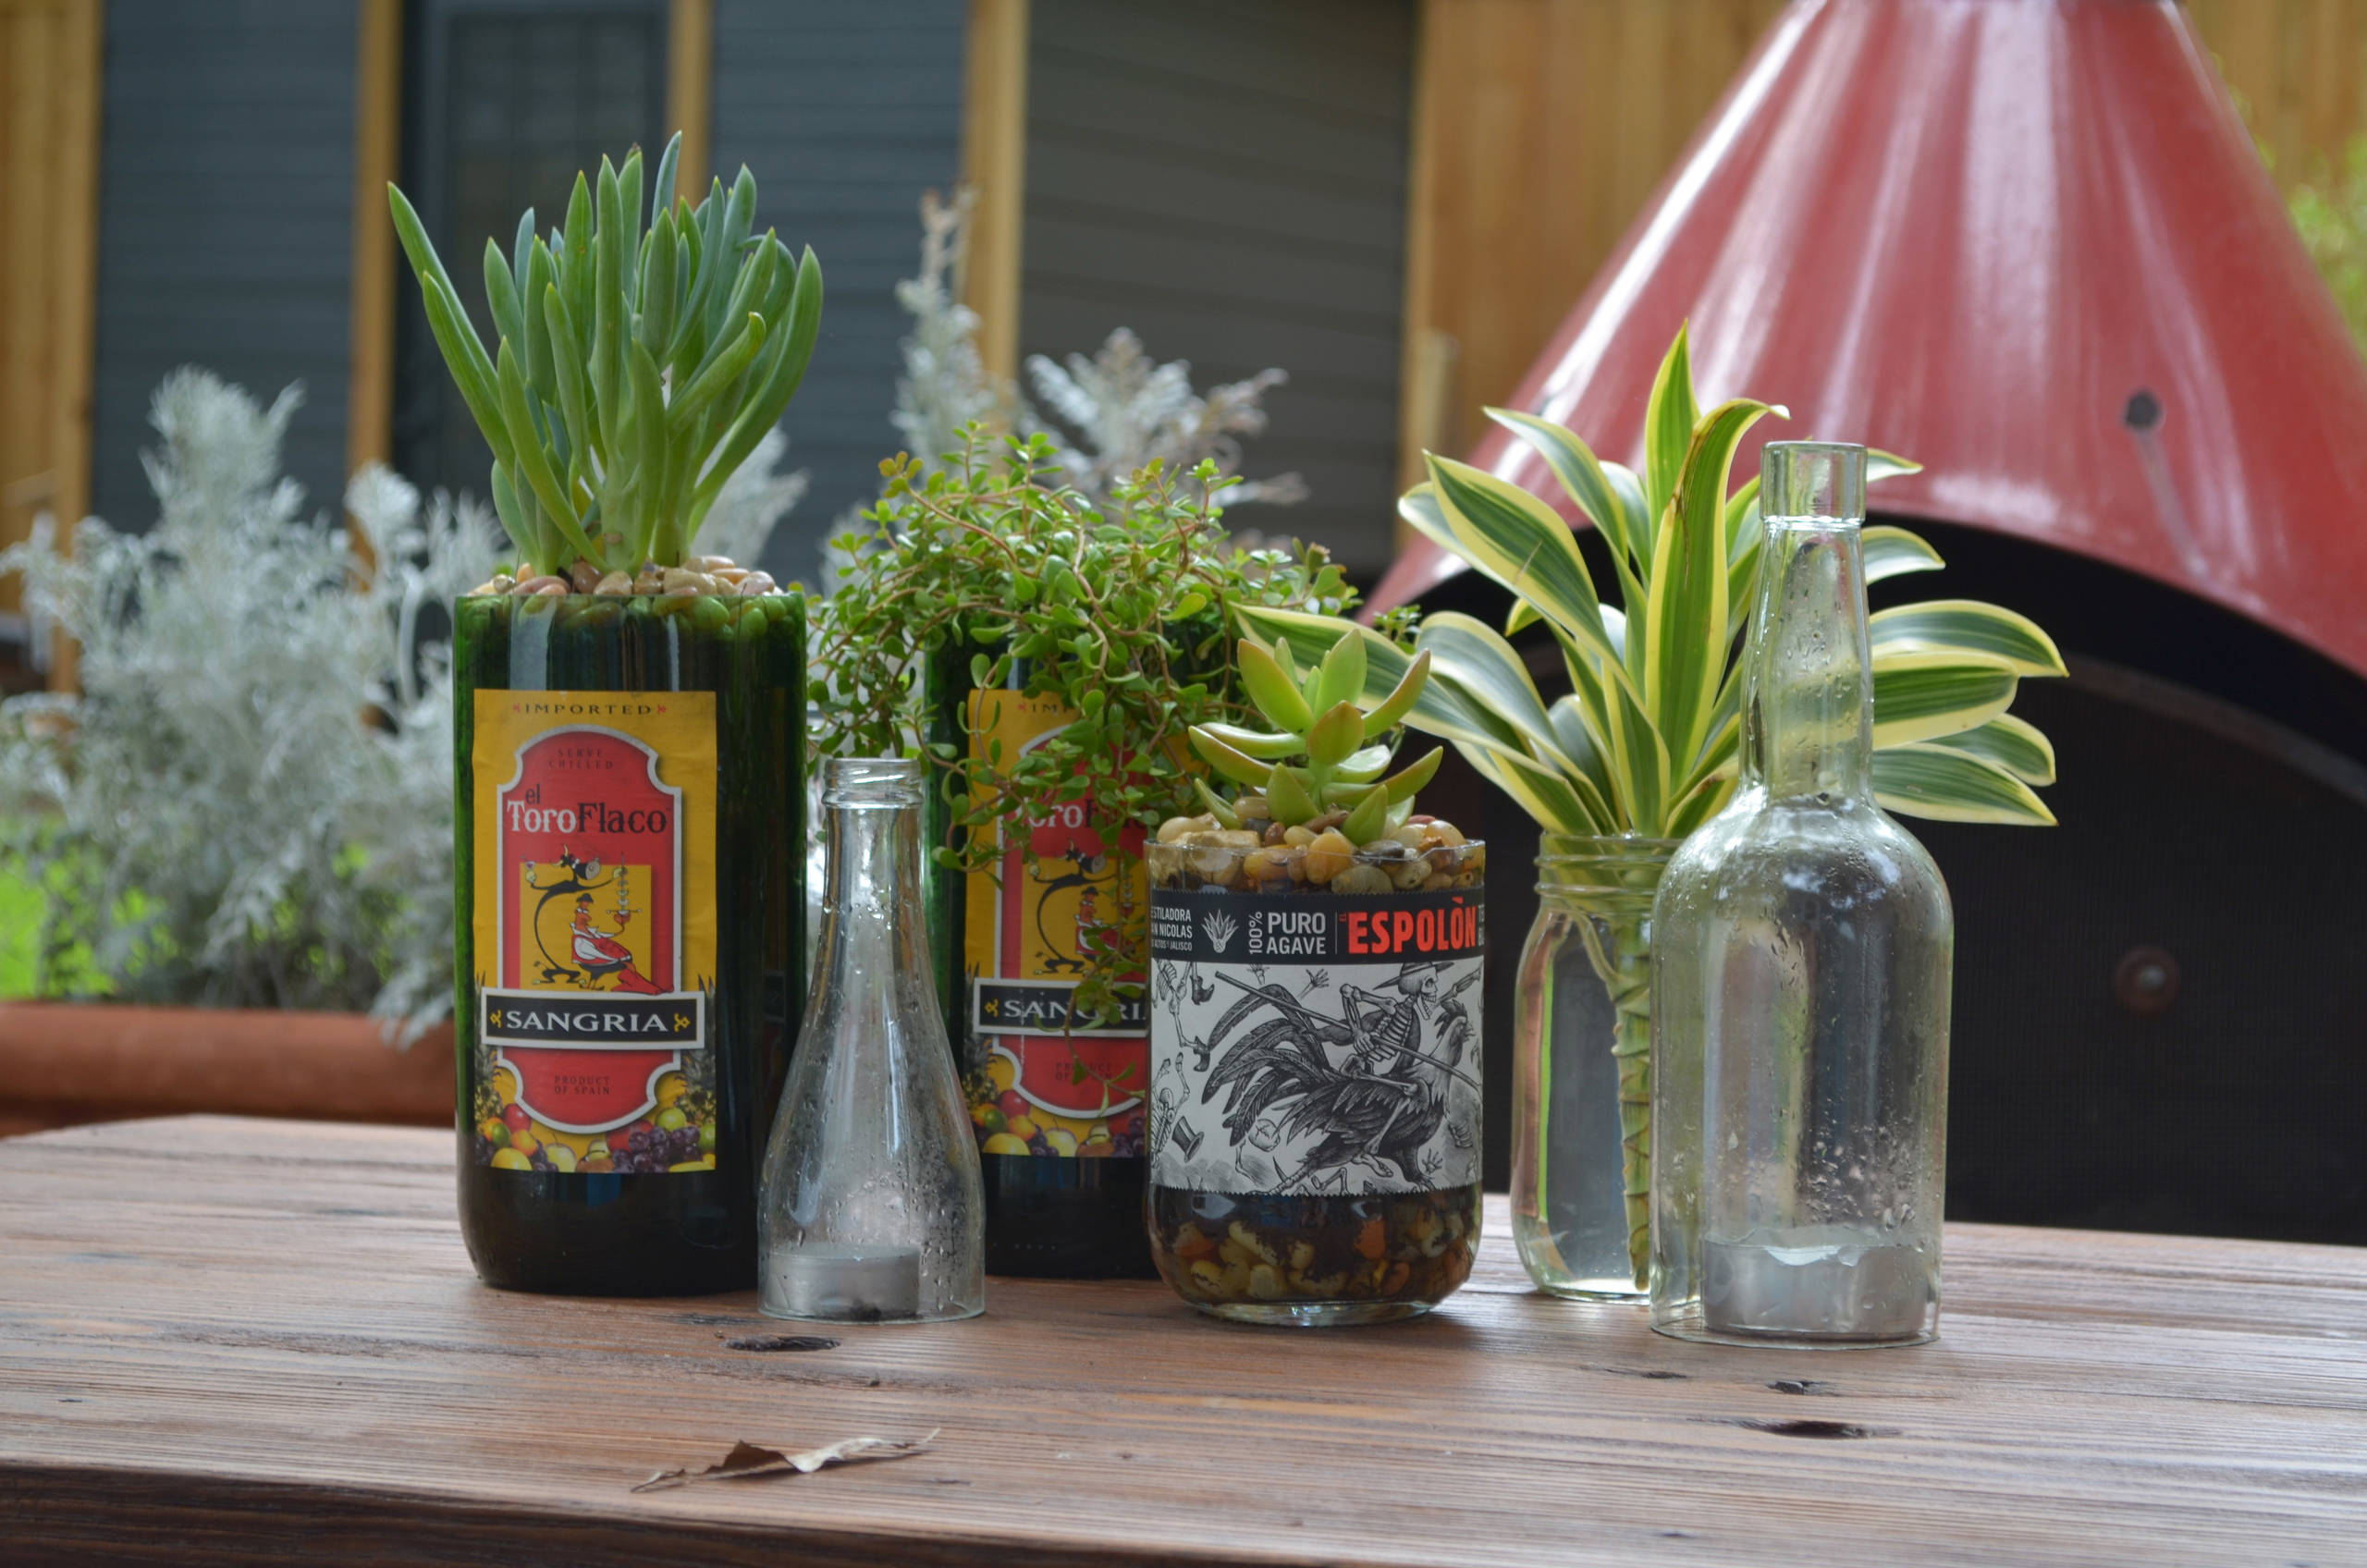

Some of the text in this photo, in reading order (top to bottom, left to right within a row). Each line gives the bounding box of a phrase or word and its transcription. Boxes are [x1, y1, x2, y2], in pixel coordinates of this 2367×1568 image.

[524, 704, 652, 716] IMPORTED
[548, 760, 613, 770] CHILLED
[525, 784, 540, 804] el
[1159, 923, 1193, 939] NICOLAS
[1268, 912, 1327, 934] PURO
[1248, 911, 1263, 955] 100%
[1266, 937, 1327, 955] AGAVE
[506, 1010, 669, 1033] SANGRIA
[555, 1075, 610, 1085] PRODUCT
[555, 1086, 610, 1096] OF SPAIN
